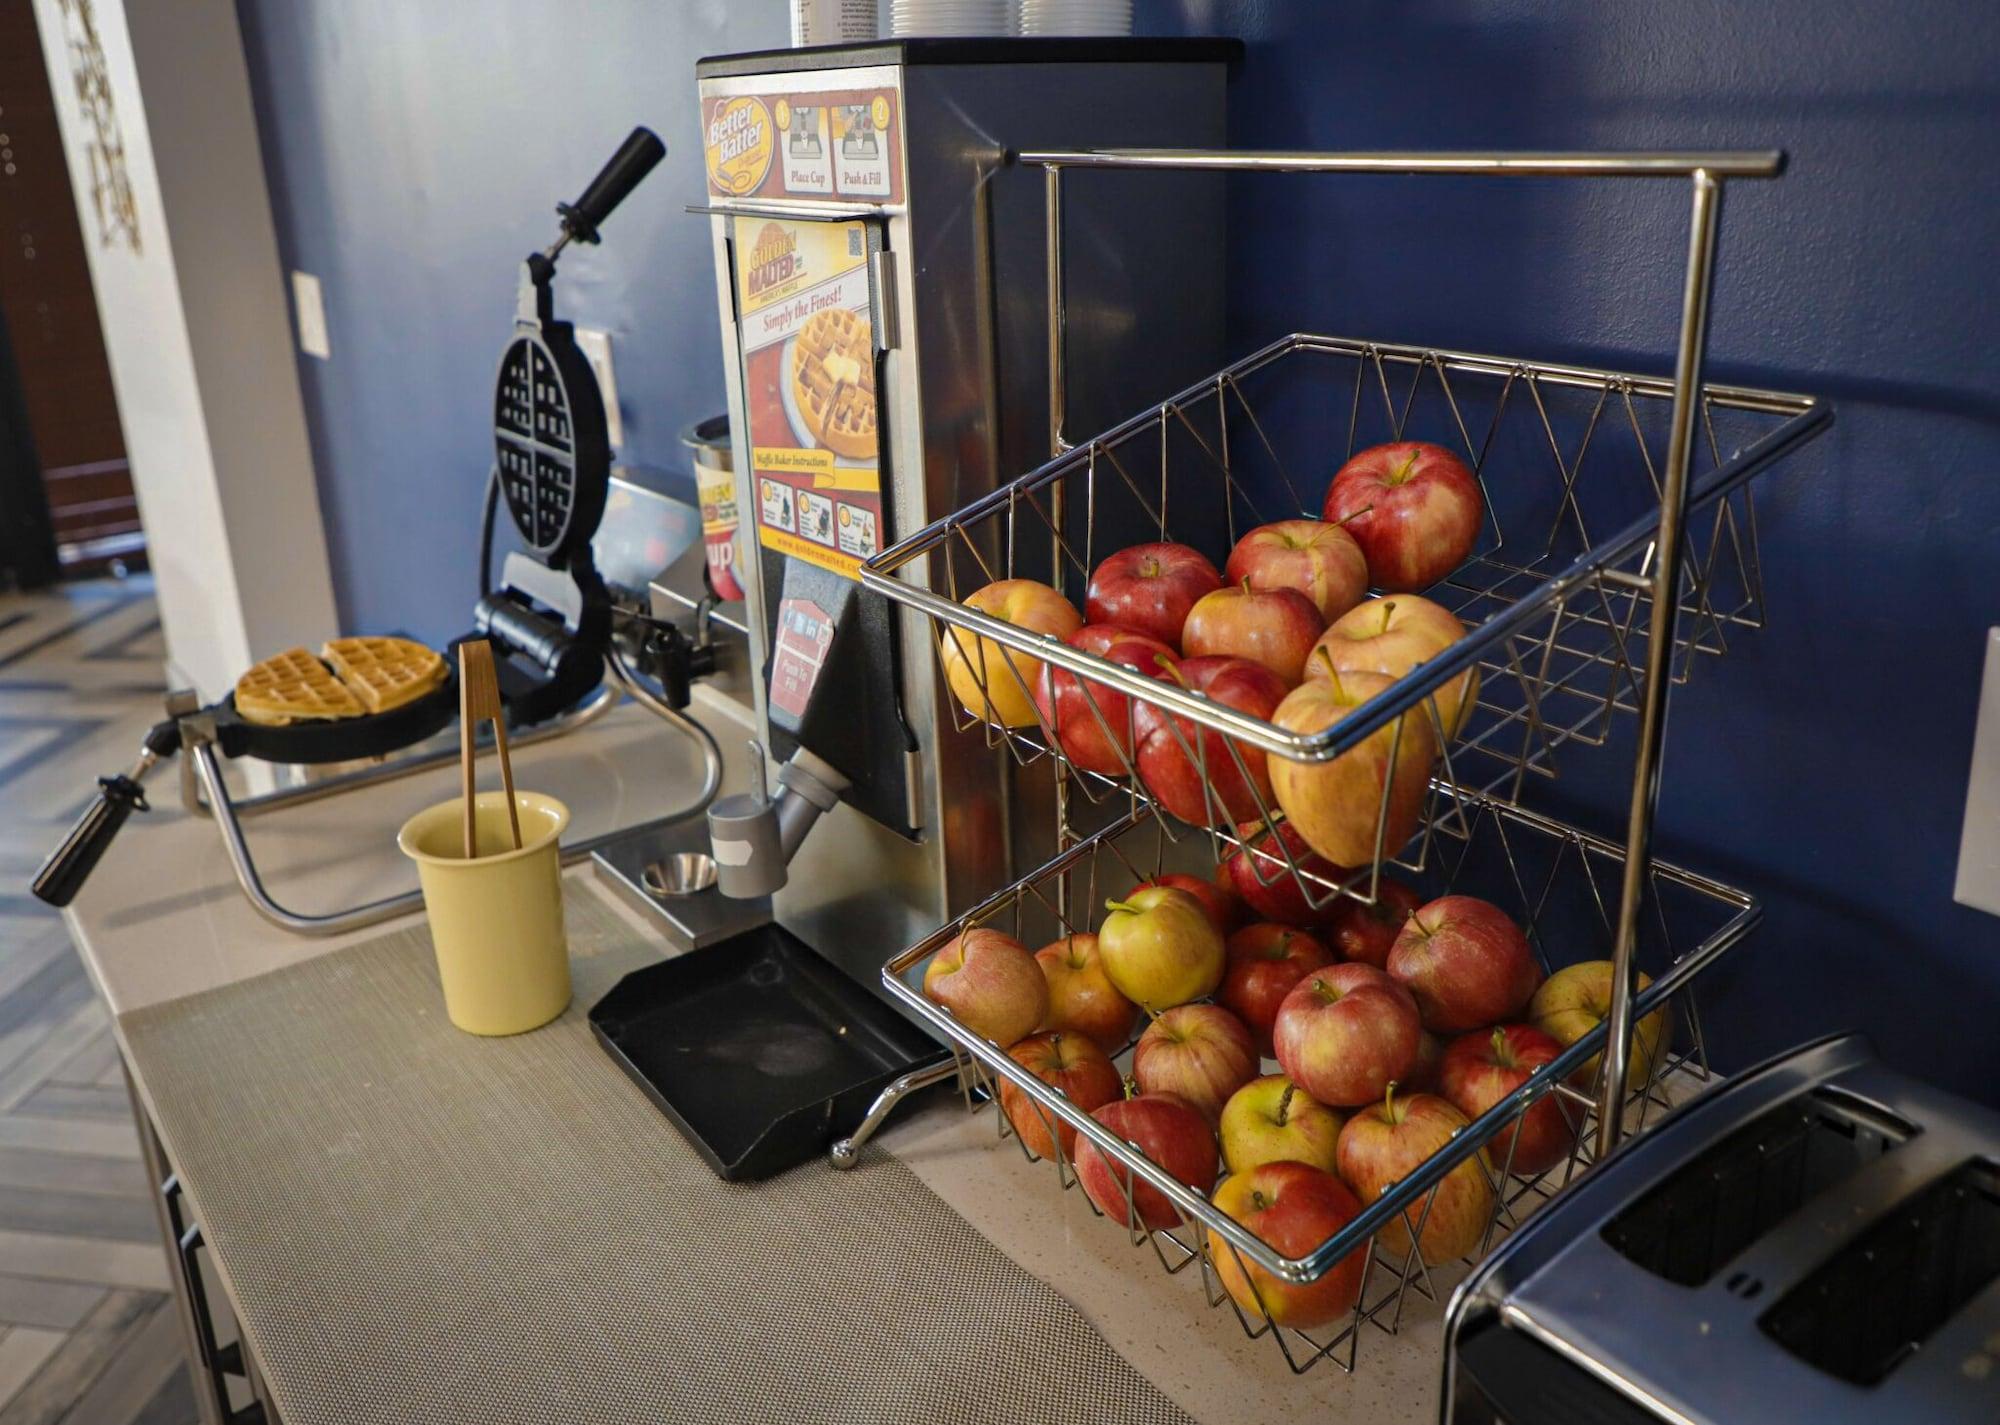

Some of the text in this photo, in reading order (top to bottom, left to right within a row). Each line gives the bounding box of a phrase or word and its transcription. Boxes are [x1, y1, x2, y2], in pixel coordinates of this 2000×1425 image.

[710, 103, 753, 147] Better
[719, 121, 762, 165] Batter
[791, 170, 825, 186] Place Cup
[844, 172, 861, 185] Push
[868, 171, 881, 185] Fill
[748, 254, 794, 296] MALTED
[763, 285, 842, 332] Simply the Finest!
[756, 454, 828, 468] Waffle Baker Instructions
